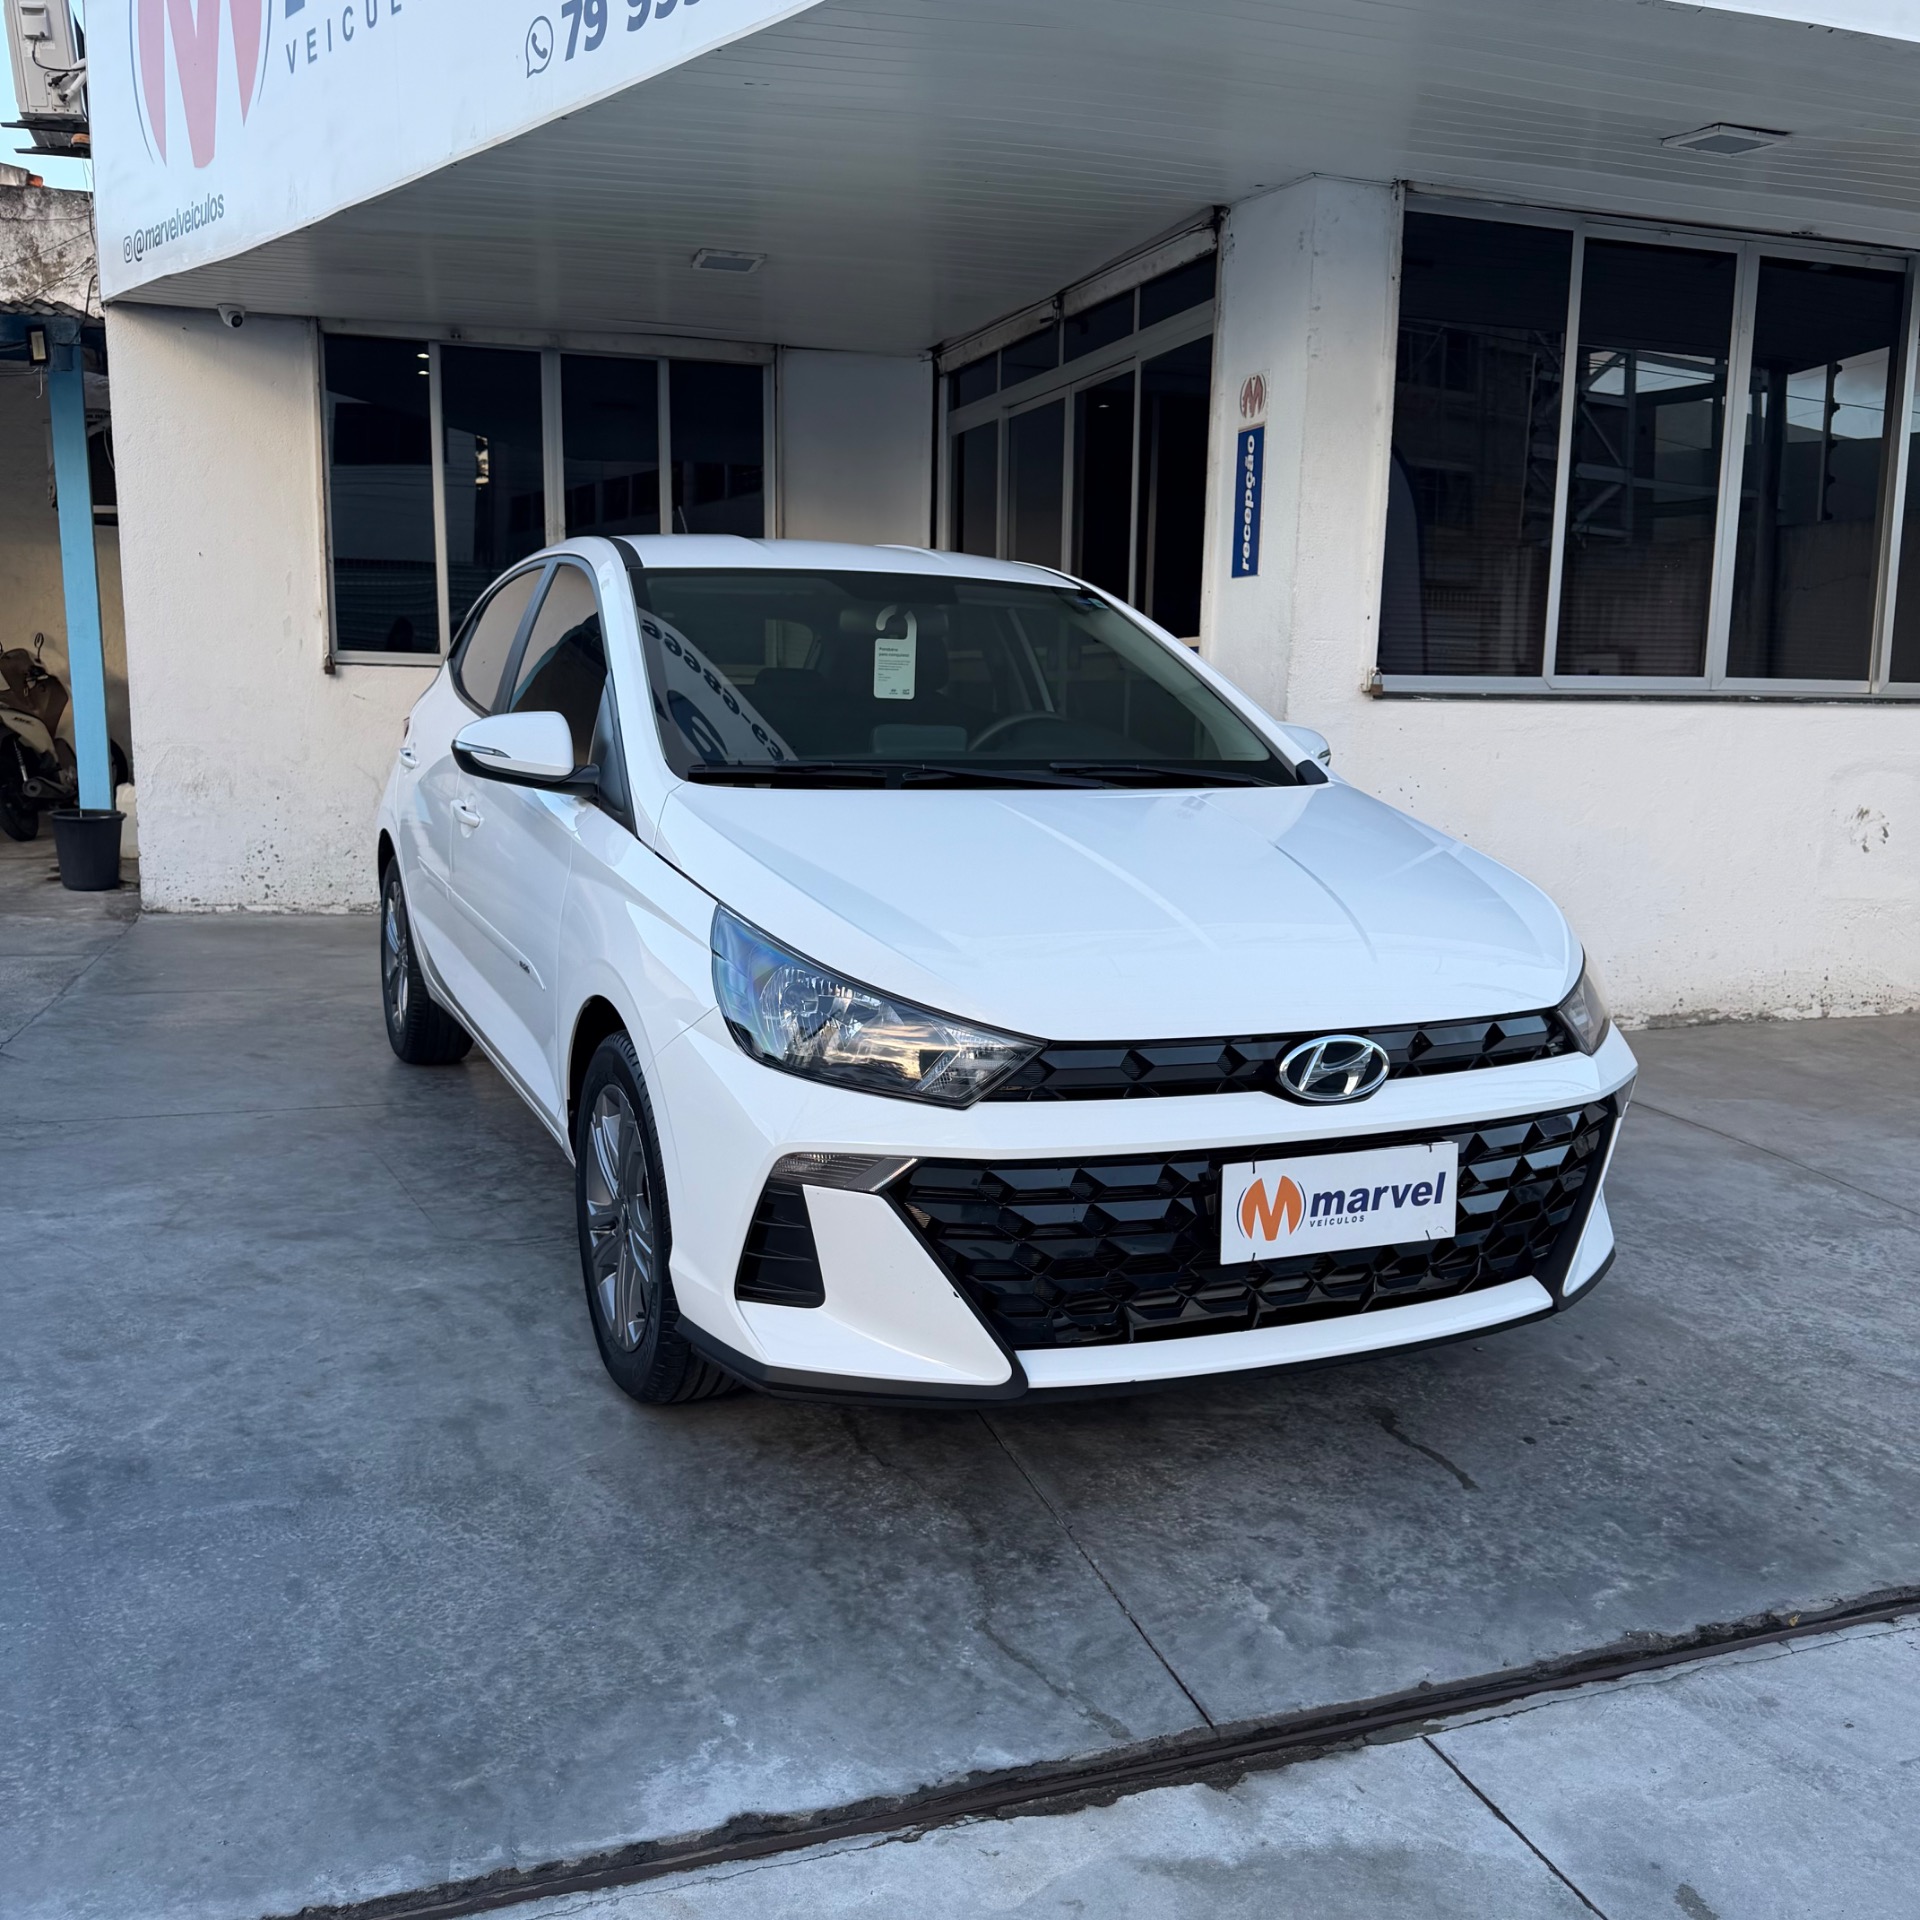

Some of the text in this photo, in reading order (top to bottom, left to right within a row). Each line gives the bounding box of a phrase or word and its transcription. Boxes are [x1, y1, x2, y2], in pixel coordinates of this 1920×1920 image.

[134, 193, 225, 262] @marvelveiculos
[1242, 434, 1256, 571] recepção
[1309, 1172, 1446, 1218] marvel
